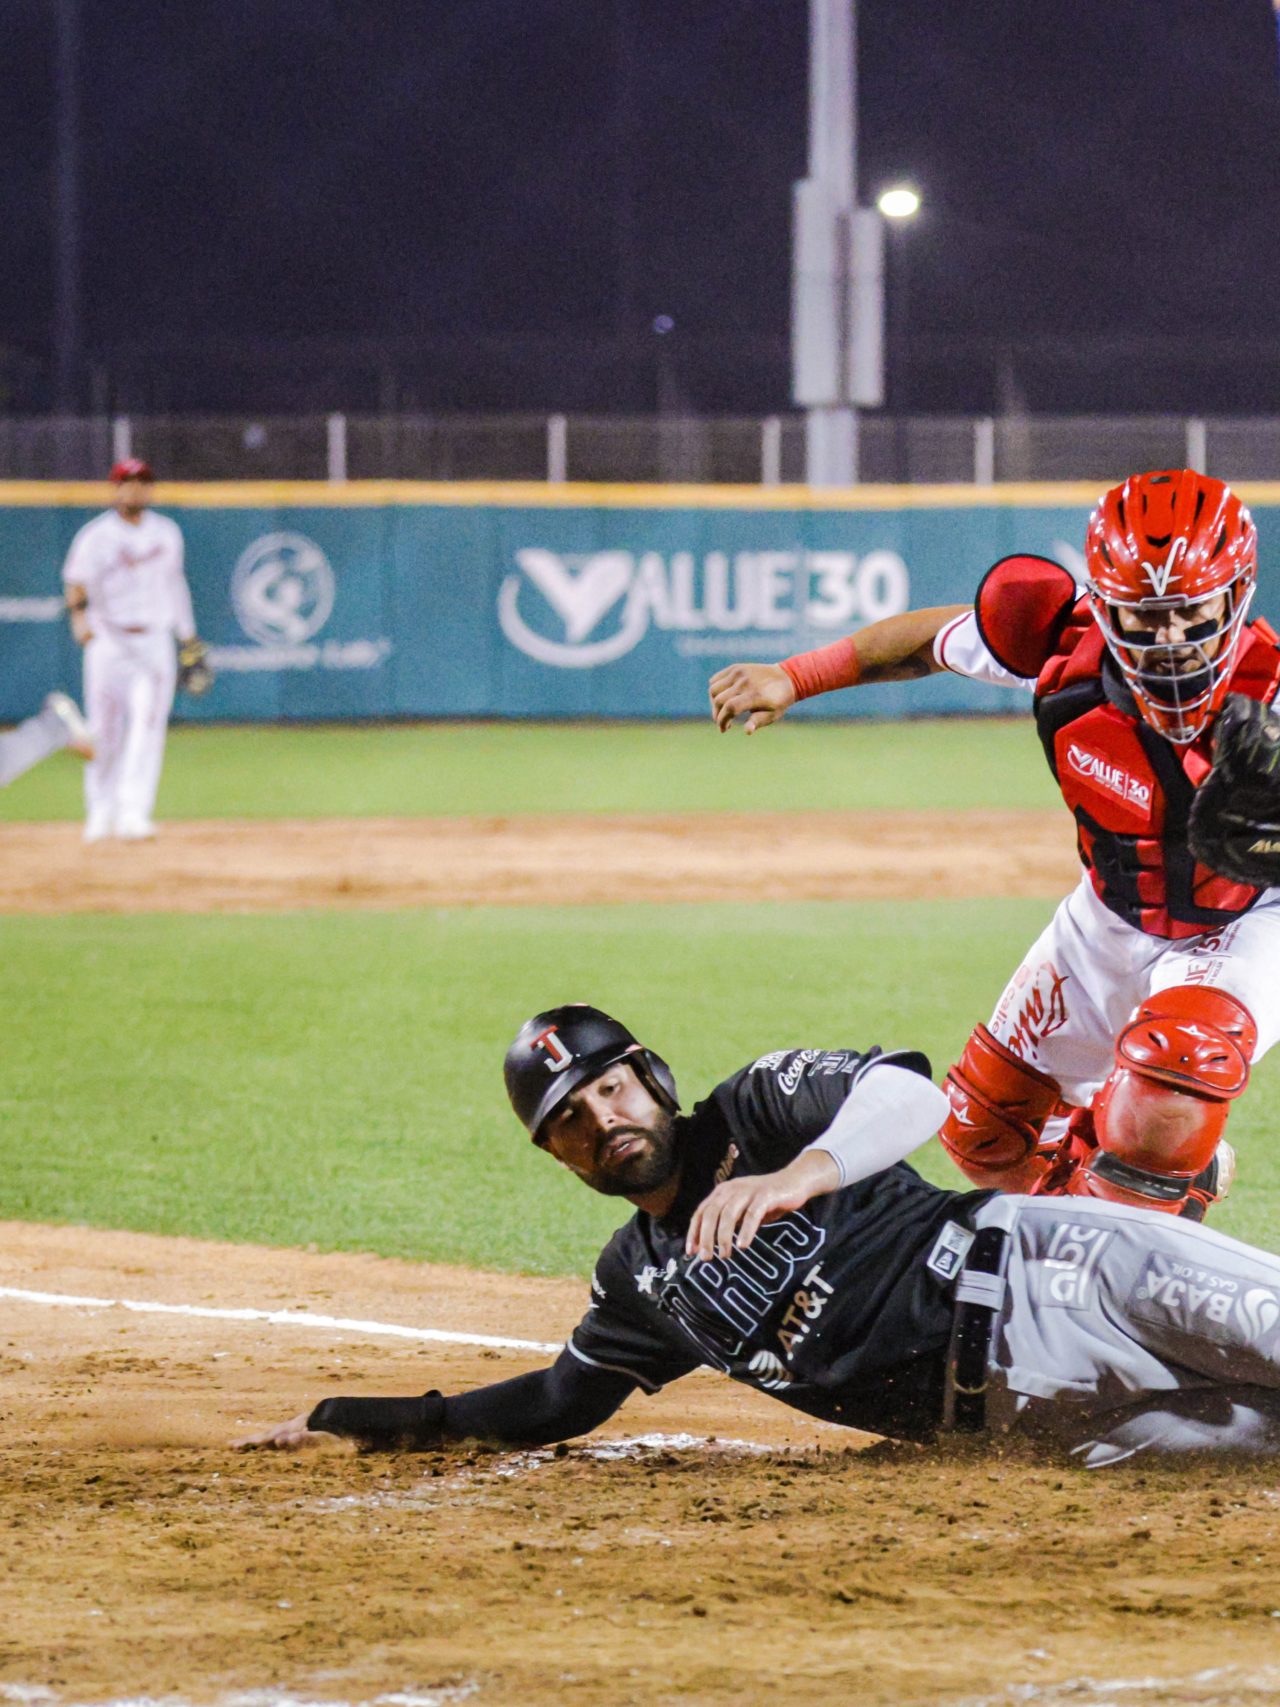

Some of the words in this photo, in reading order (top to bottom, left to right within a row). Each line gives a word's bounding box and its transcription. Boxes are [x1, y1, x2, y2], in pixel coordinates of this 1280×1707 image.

[805, 549, 911, 625] 30
[1129, 779, 1150, 801] 30
[1170, 1261, 1194, 1280] OIL
[1207, 1274, 1239, 1293] GAS
[775, 1259, 835, 1361] AT&T
[1145, 1269, 1234, 1325] BAJA
